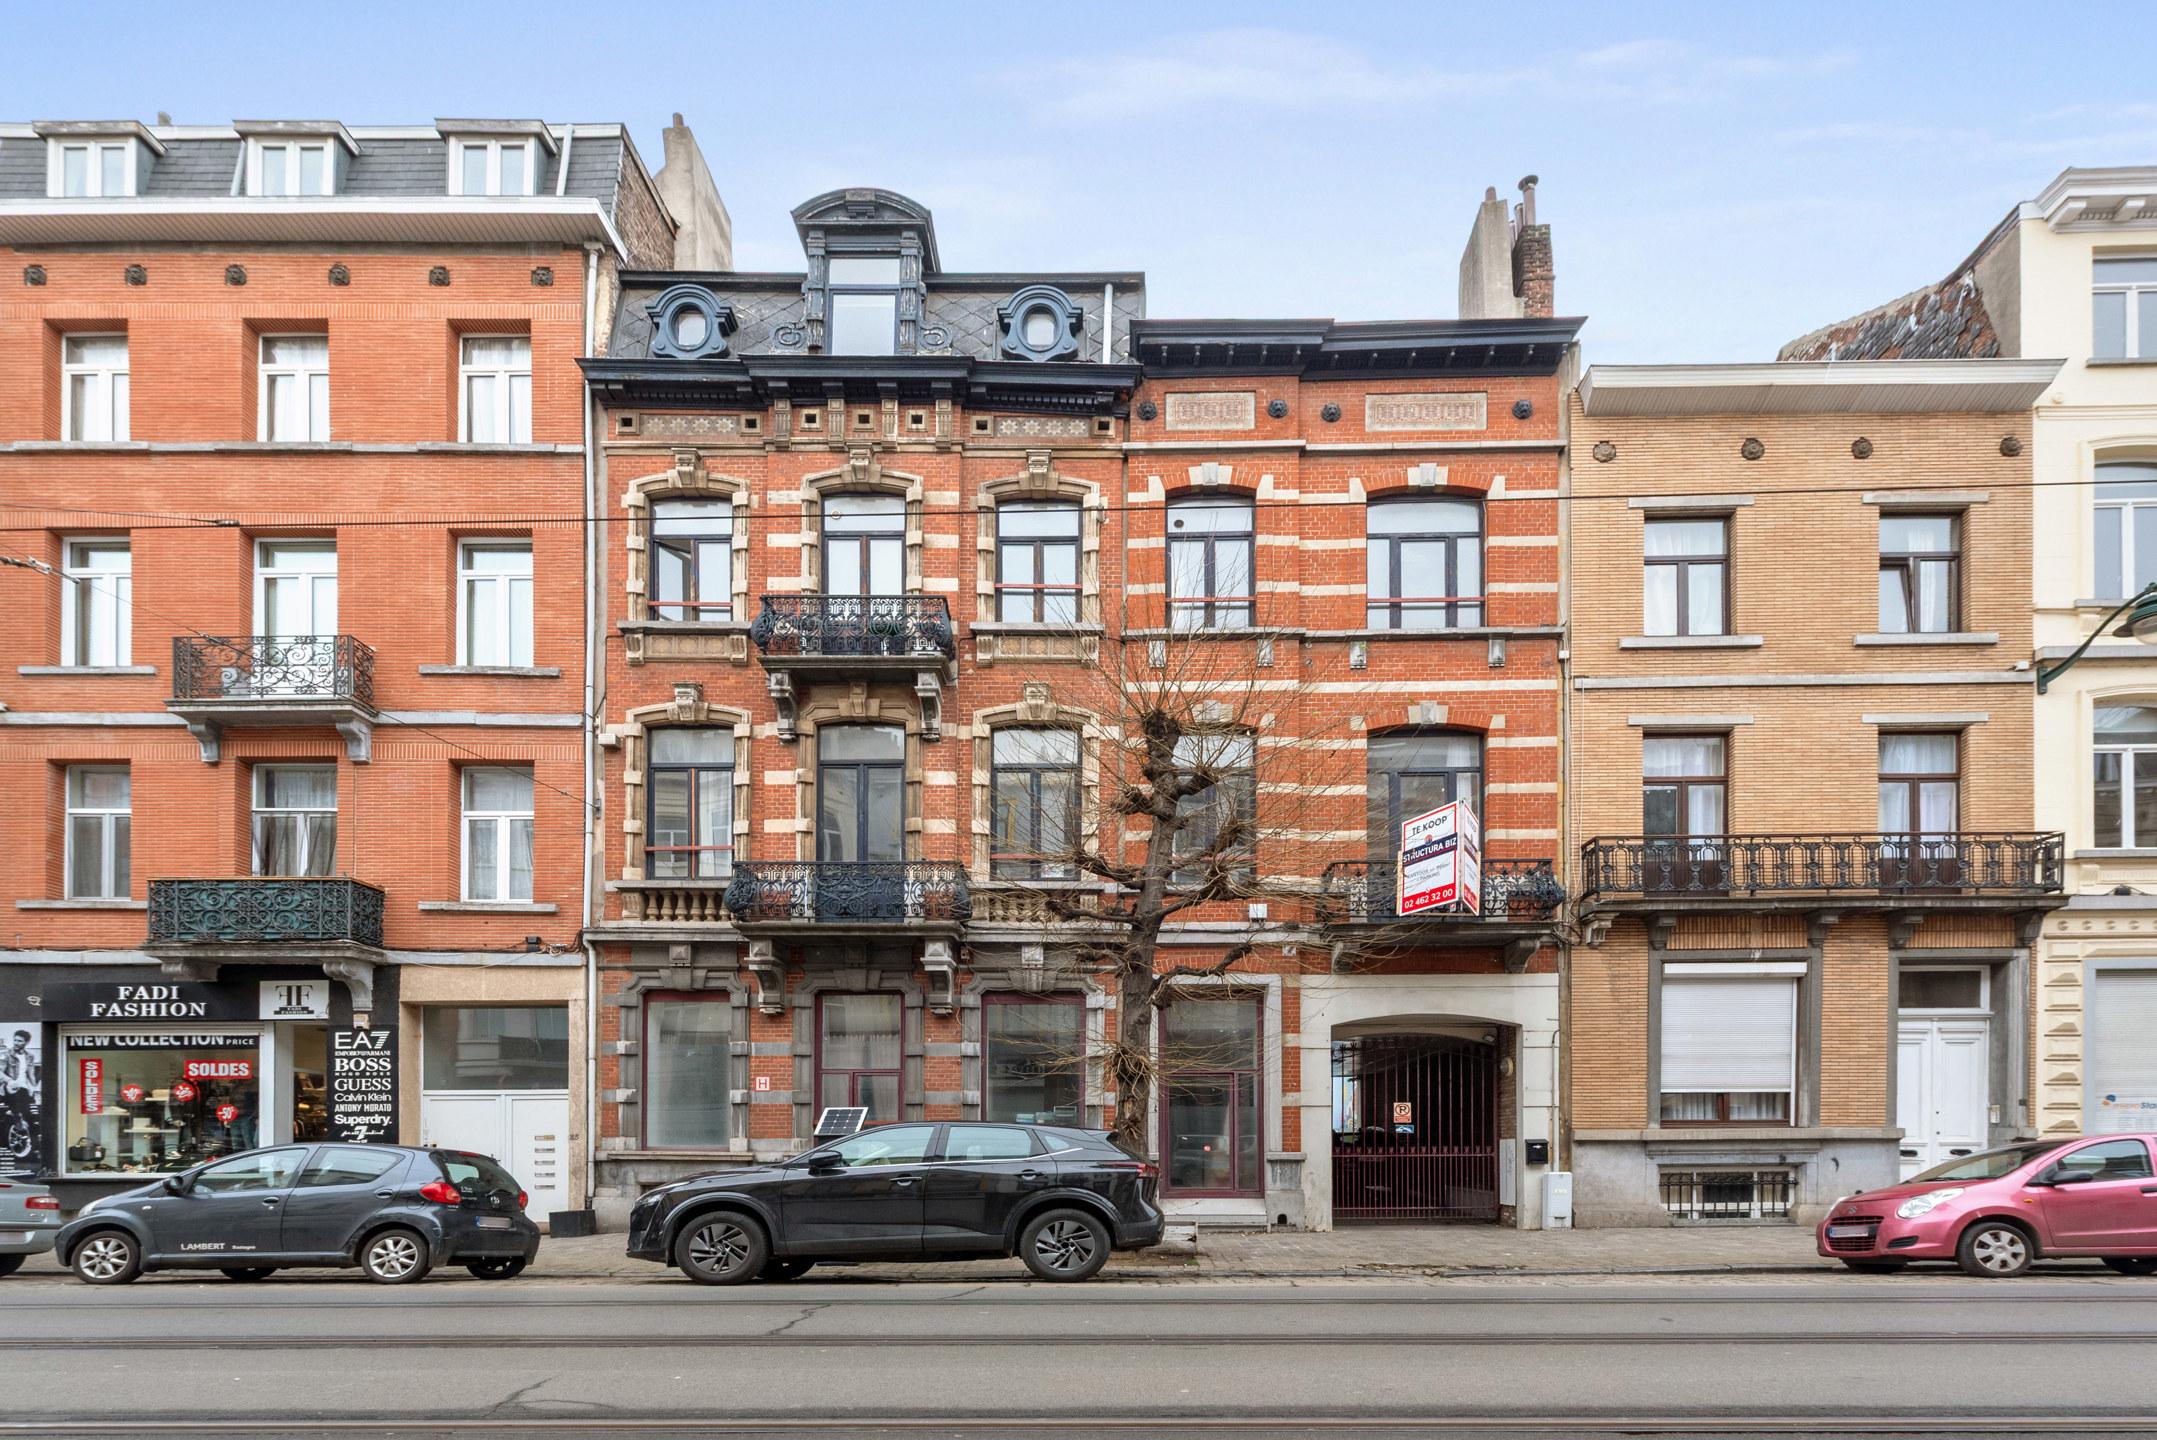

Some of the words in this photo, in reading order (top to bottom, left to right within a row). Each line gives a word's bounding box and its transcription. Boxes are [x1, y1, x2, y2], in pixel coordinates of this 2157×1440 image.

[1412, 825, 1420, 836] TE
[1422, 815, 1447, 831] KOOP
[1403, 842, 1443, 863] STRUCTURA
[1445, 838, 1456, 848] BIZ
[1404, 900, 1414, 909] 02
[1415, 895, 1429, 906] 462
[1431, 892, 1441, 902] 32
[1442, 888, 1453, 898] 00
[117, 985, 180, 1000] FADI
[89, 1002, 207, 1017] FASHION
[70, 1035, 110, 1046] NEW
[114, 1035, 224, 1046] COLLECTION
[334, 1031, 391, 1049] EA7
[188, 1062, 249, 1077] SOLDES
[334, 1057, 392, 1071] BOSS
[85, 1061, 98, 1112] SOLDES
[334, 1078, 392, 1091] GUESS
[758, 1078, 767, 1089] H
[334, 1093, 367, 1102] Calvin
[368, 1093, 392, 1101] Klein
[334, 1103, 362, 1112] ANTONY
[364, 1103, 392, 1112] MORATO
[334, 1114, 393, 1126] Superdry.
[180, 1242, 225, 1250] LAMBERT
